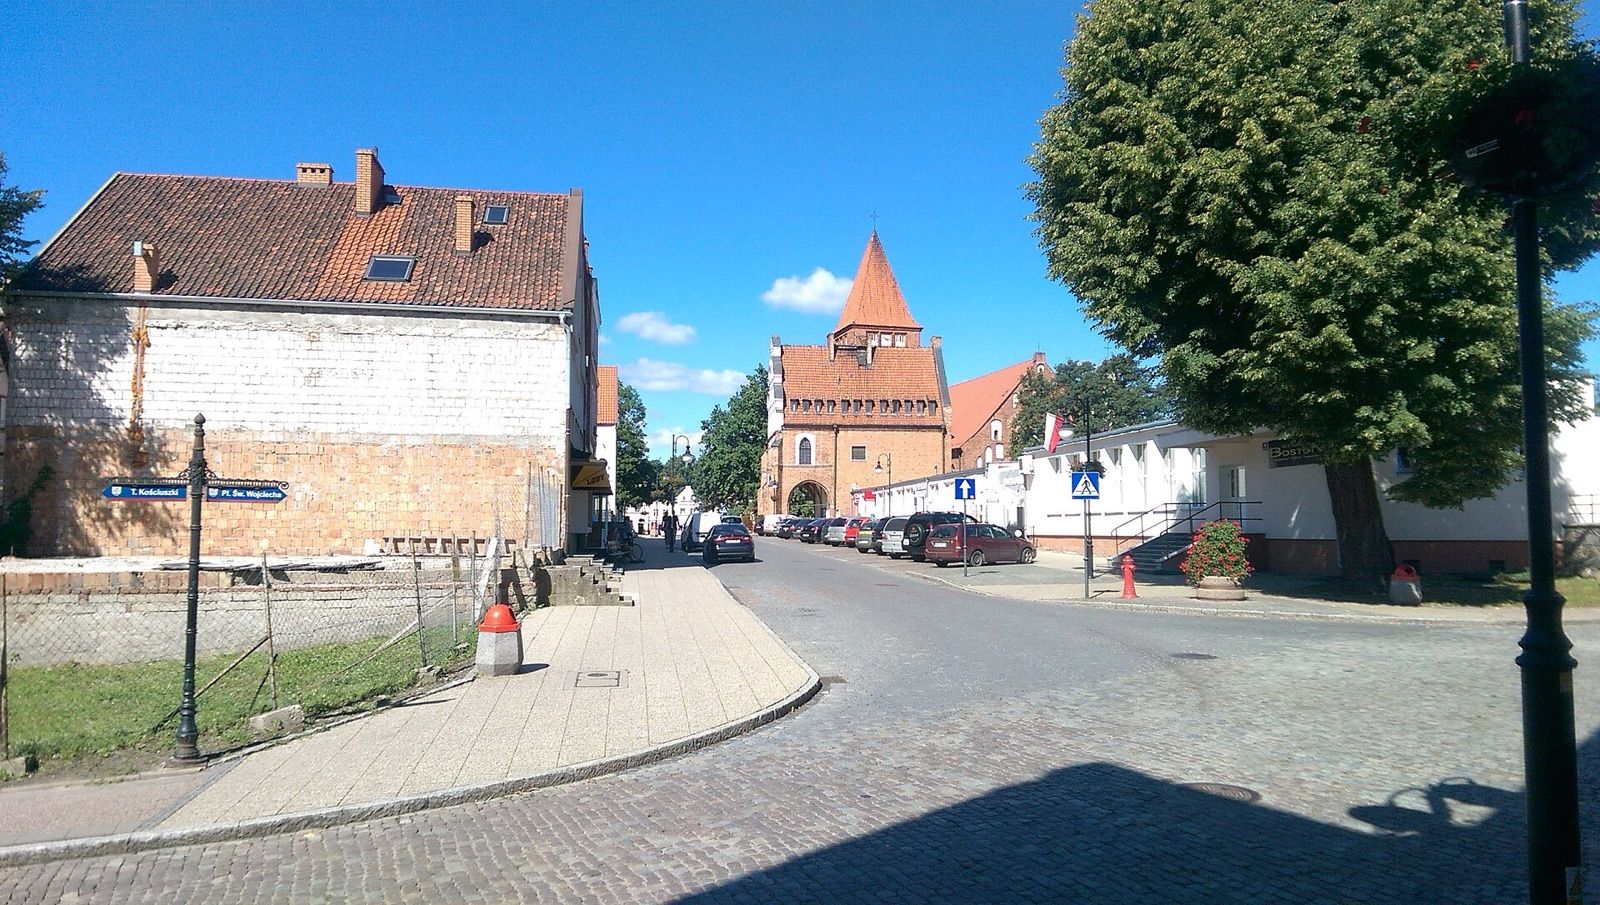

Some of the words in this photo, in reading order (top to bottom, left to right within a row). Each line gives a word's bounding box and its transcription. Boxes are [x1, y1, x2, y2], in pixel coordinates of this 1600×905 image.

[586, 474, 605, 486] LODY
[130, 488, 137, 496] T.
[138, 488, 179, 496] Kościuszki
[221, 489, 231, 497] Pl.
[232, 488, 245, 497] Św.
[245, 490, 282, 499] Wojciecha
